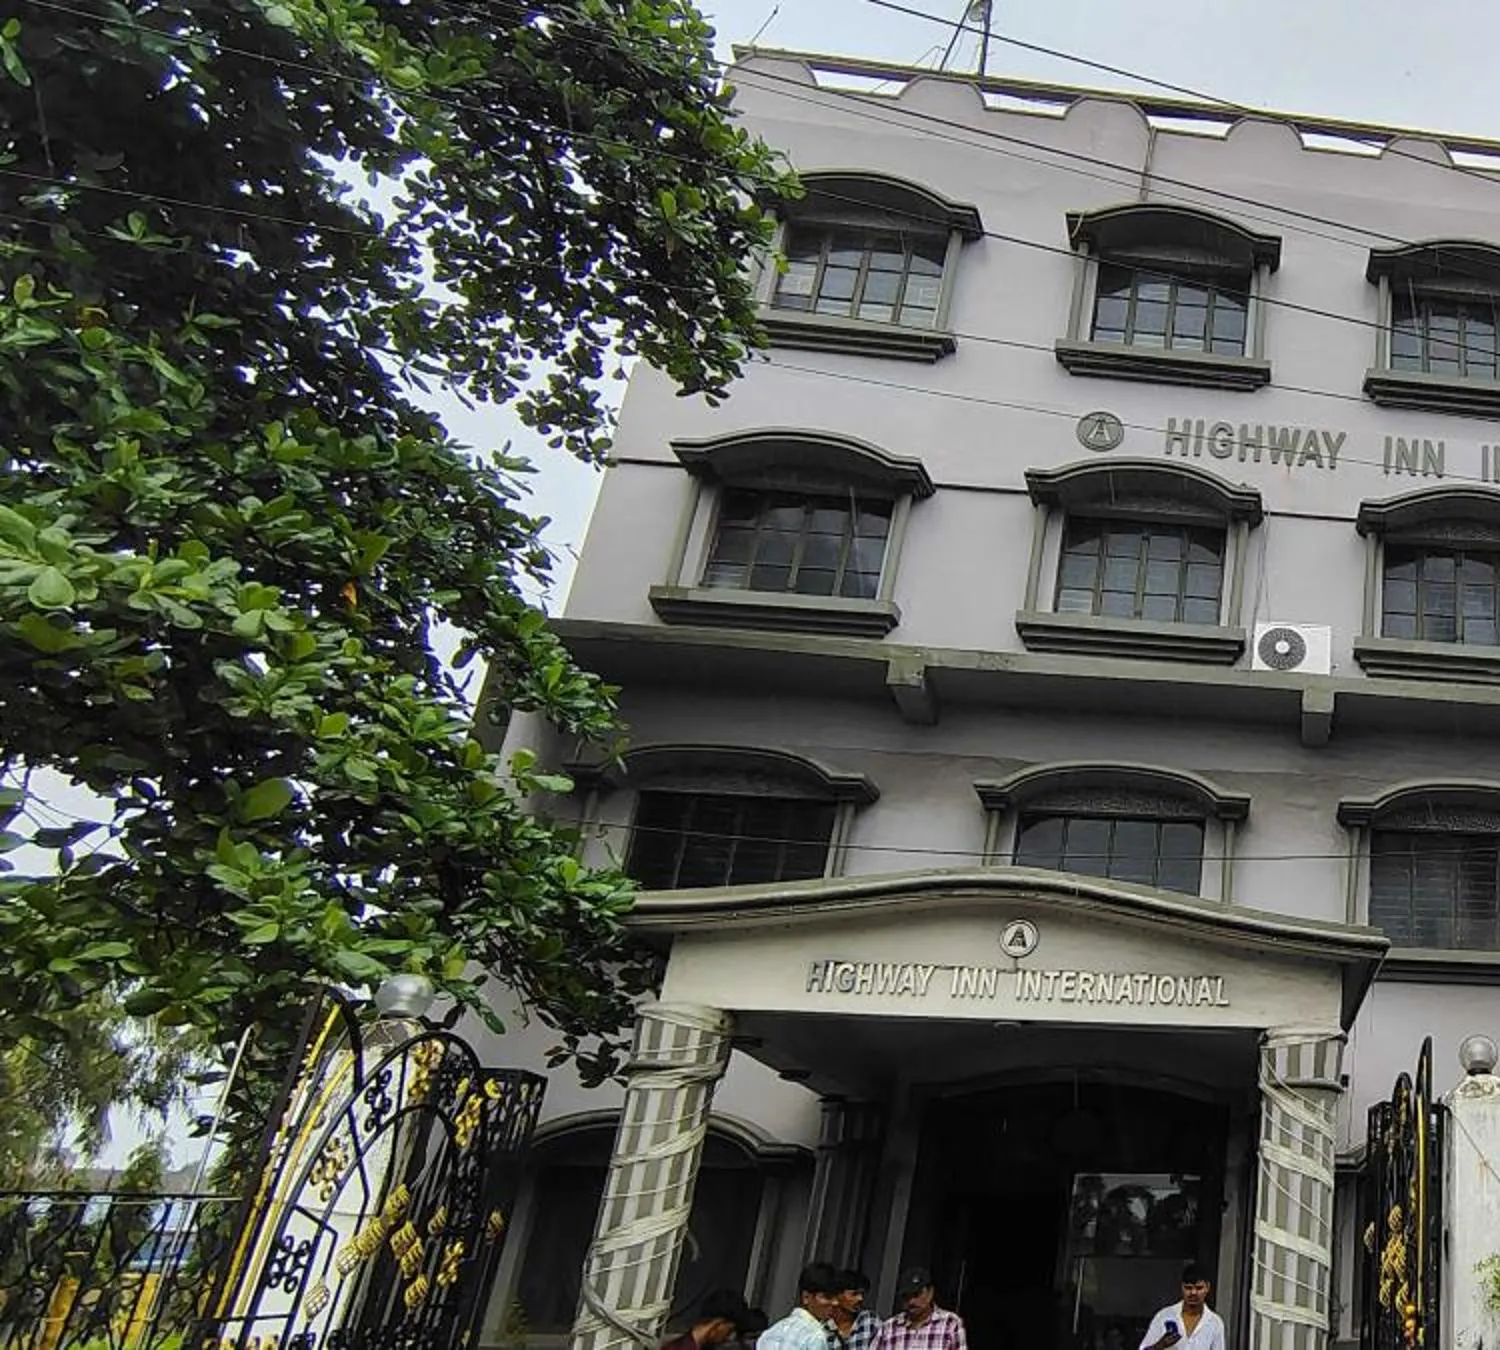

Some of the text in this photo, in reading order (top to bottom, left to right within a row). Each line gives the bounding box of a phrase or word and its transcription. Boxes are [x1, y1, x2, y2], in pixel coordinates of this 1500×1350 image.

[1164, 417, 1347, 469] HIGHWAY
[1383, 435, 1446, 478] INN
[805, 960, 1230, 1007] HIGHWAY INN INTERNATIONAL
